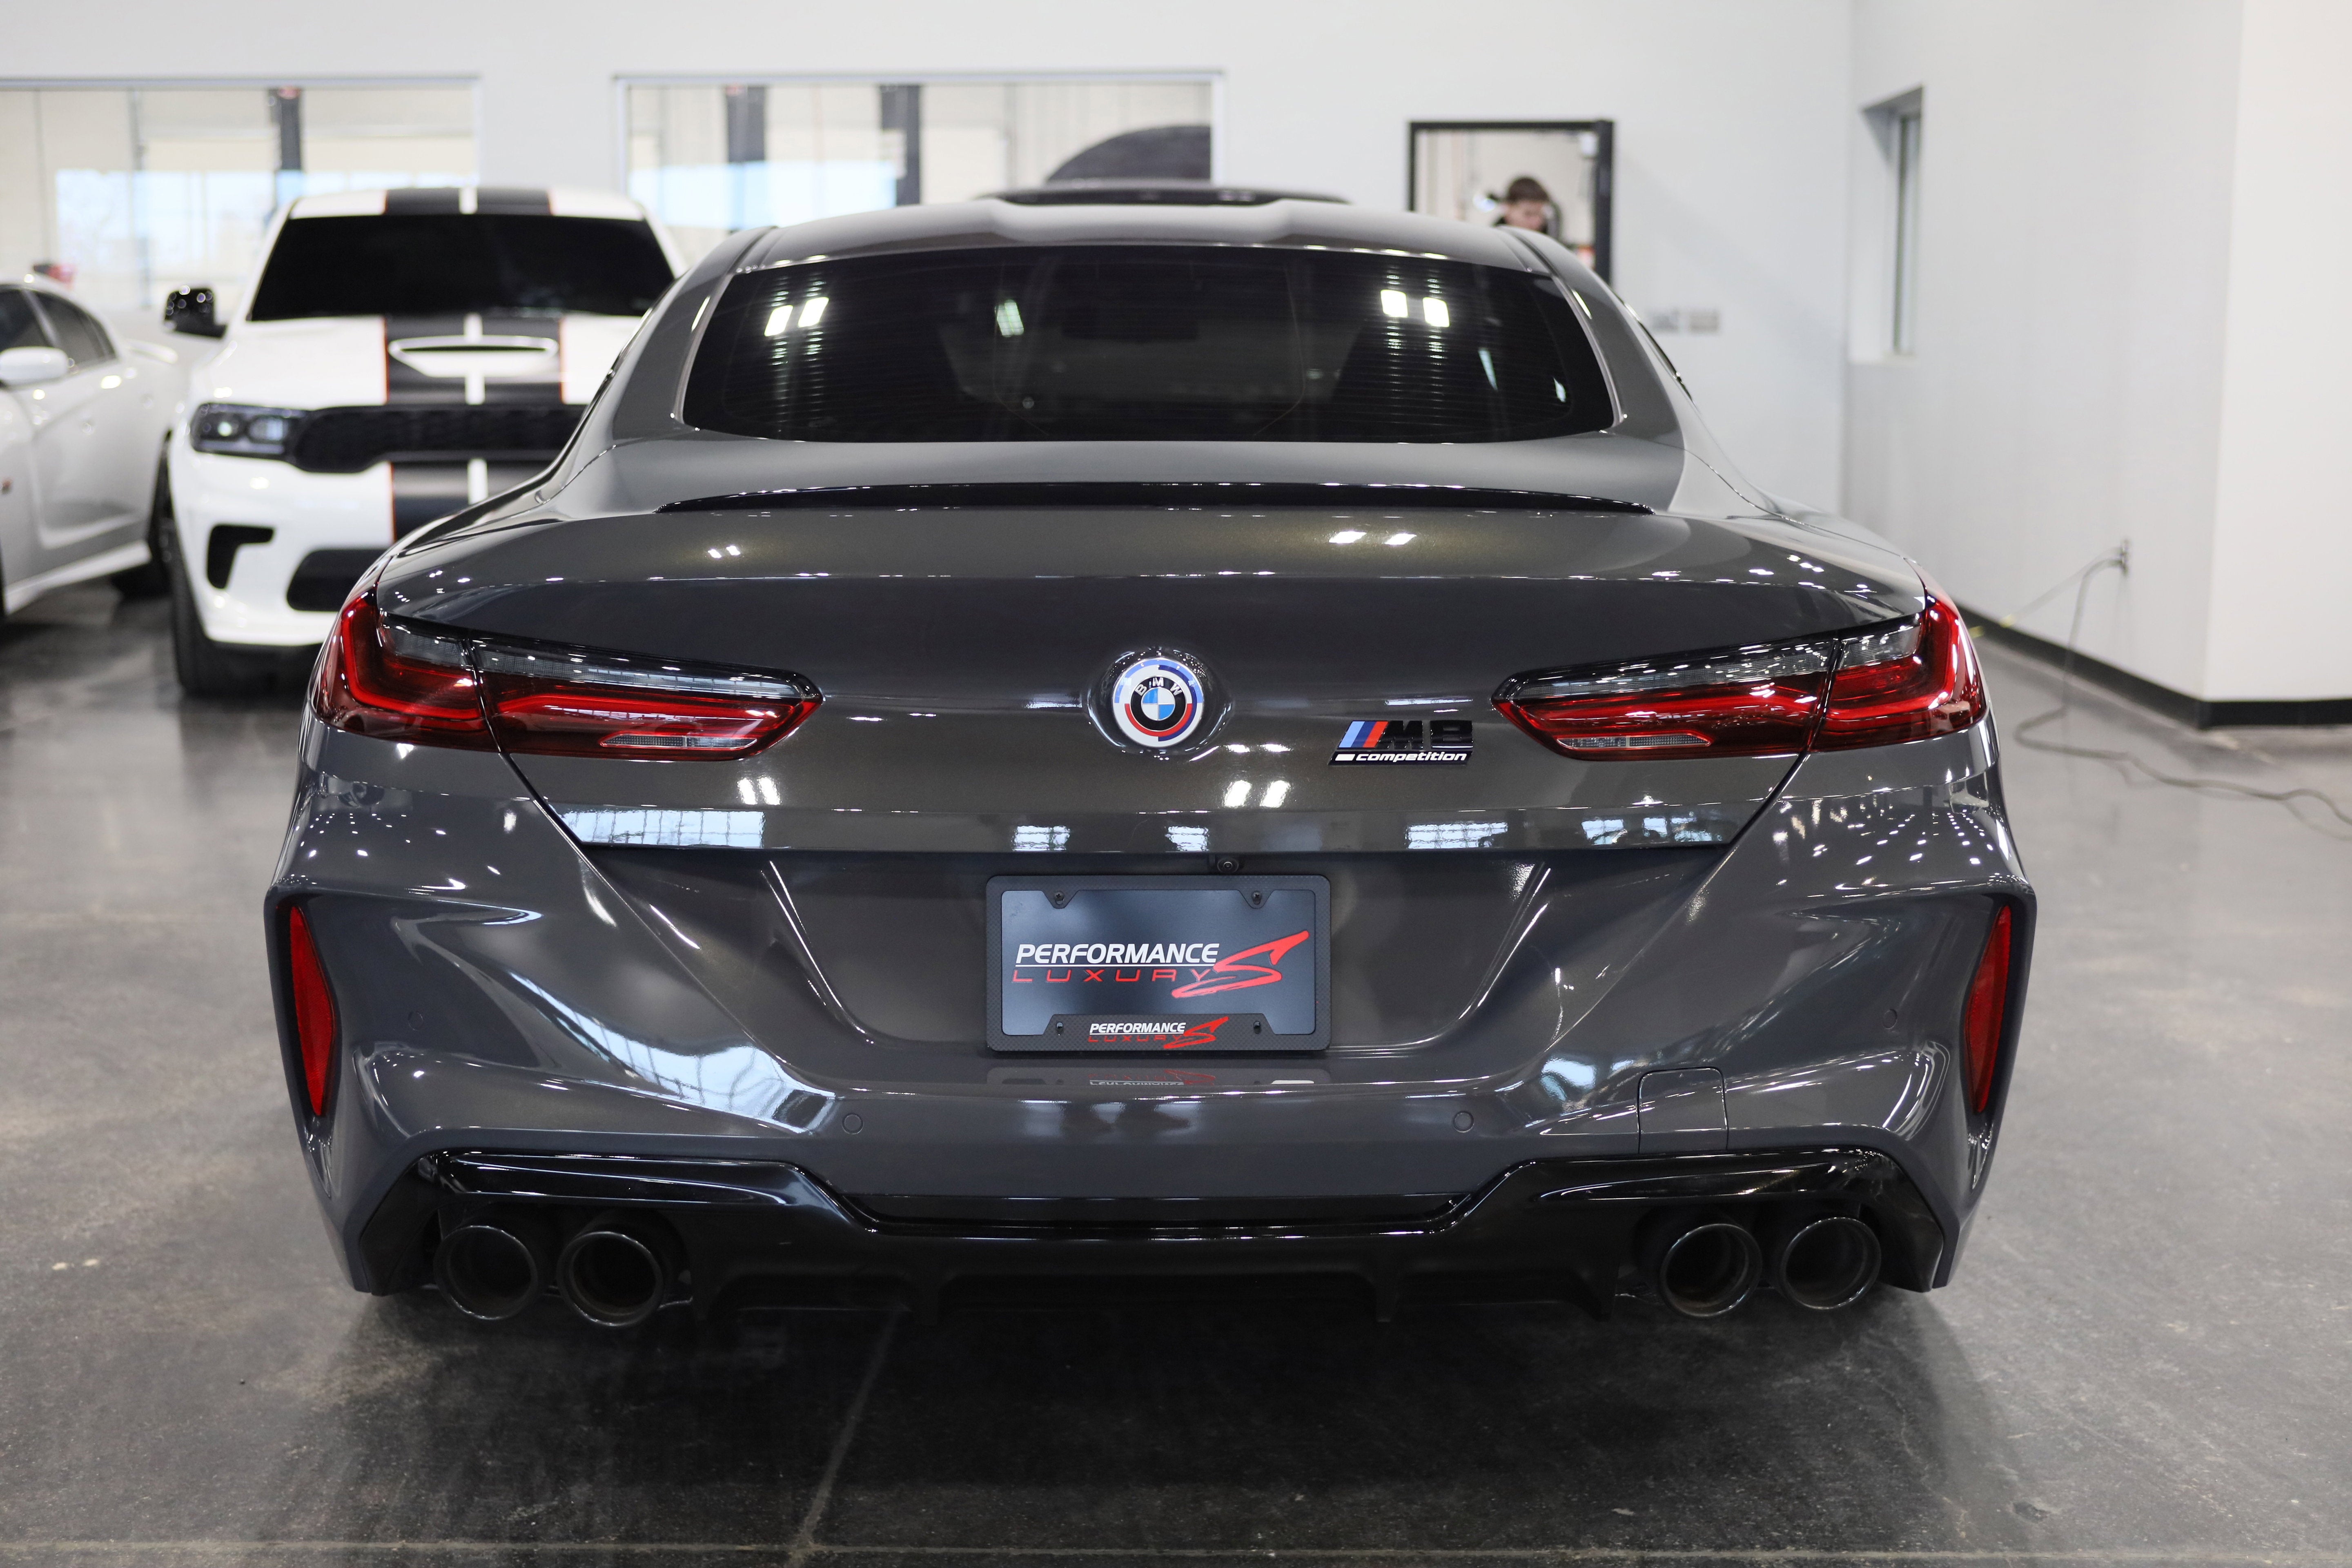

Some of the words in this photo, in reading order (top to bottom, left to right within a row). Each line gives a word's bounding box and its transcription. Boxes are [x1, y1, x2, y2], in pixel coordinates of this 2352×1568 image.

[1135, 677, 1183, 696] BMW
[1375, 720, 1474, 749] M8
[1356, 751, 1467, 762] competition
[1016, 943, 1220, 964] PERFORMANCE
[1011, 968, 1212, 982] LUXURY
[1089, 1022, 1186, 1033] PERFORMANCE
[1088, 1034, 1184, 1042] LUXURY
